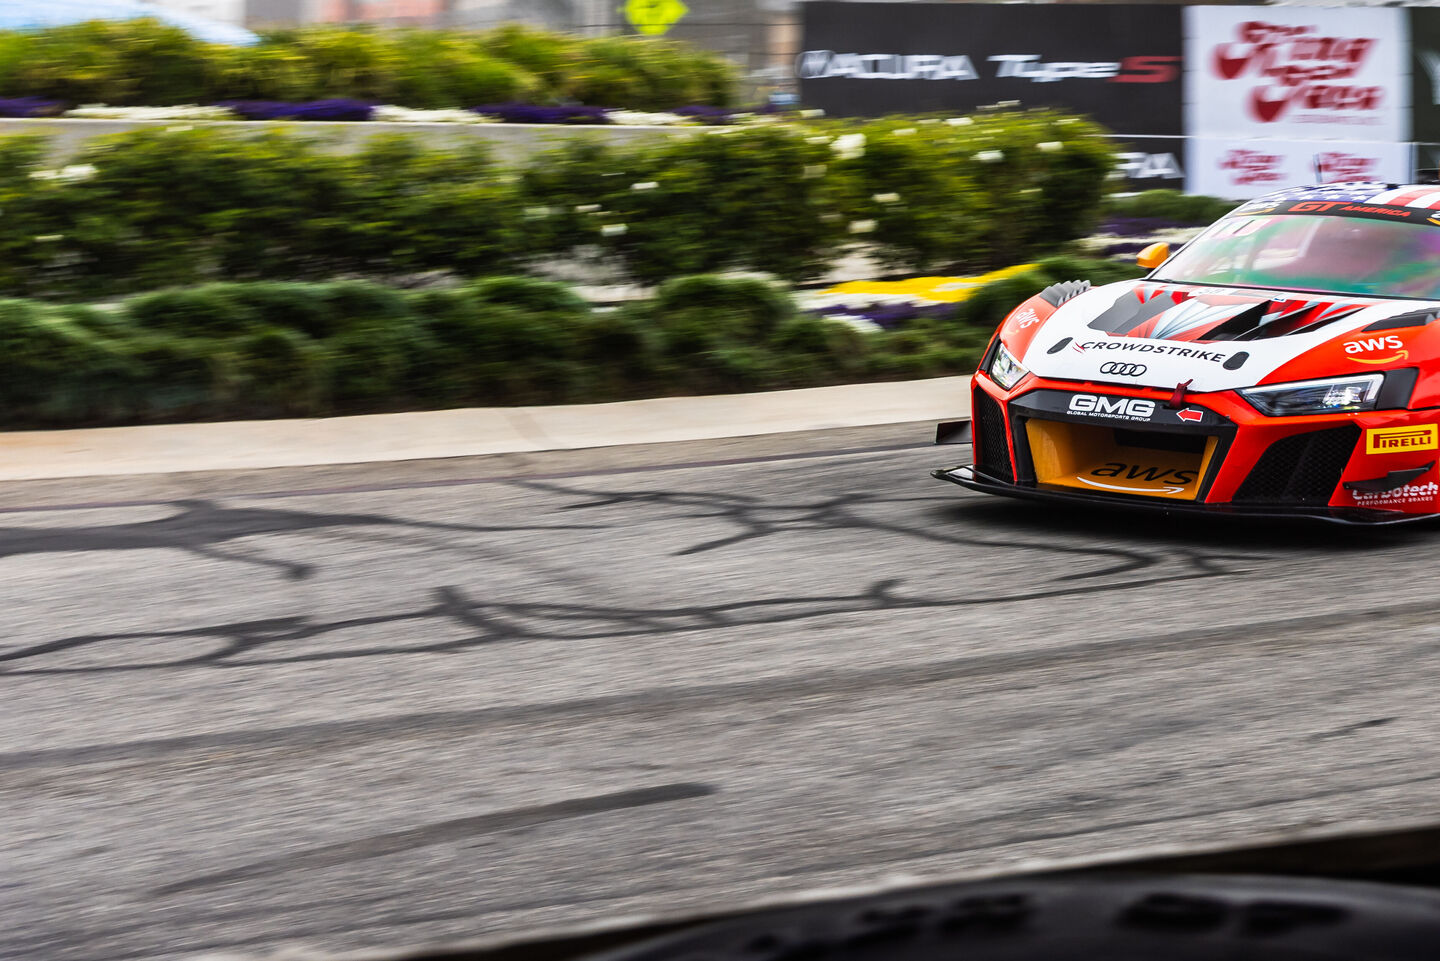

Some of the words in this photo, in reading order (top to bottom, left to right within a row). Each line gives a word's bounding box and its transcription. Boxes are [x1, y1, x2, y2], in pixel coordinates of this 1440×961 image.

[1107, 56, 1184, 83] S
[1287, 200, 1351, 213] GT
[1339, 204, 1411, 218] AMERICA
[1081, 341, 1226, 363] CROWDSTRIKE
[1343, 334, 1404, 355] aws
[1068, 394, 1156, 418] GMG
[1088, 412, 1130, 421] MOTORSPORTS
[1372, 429, 1432, 449] PIRELLI
[1090, 462, 1200, 486] aws
[1357, 497, 1406, 506] PERFORMANCE
